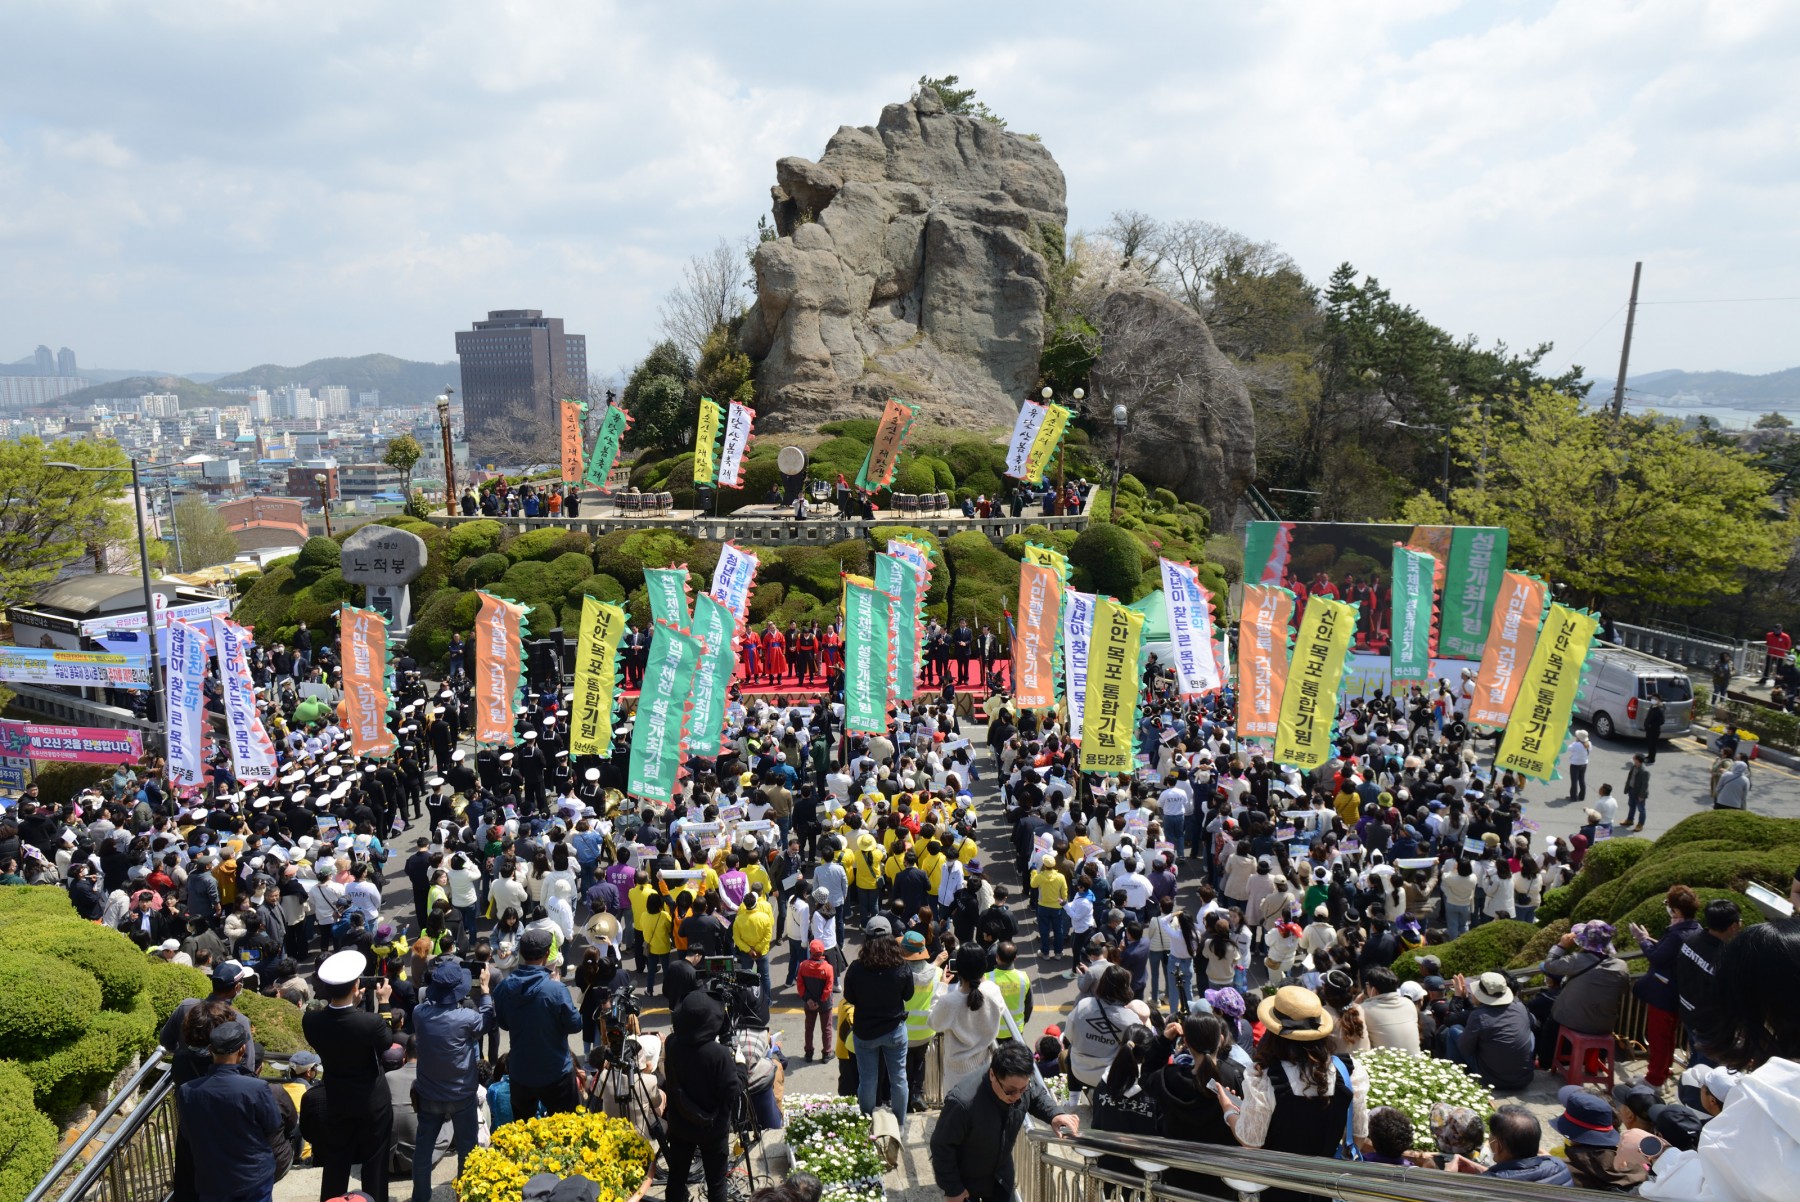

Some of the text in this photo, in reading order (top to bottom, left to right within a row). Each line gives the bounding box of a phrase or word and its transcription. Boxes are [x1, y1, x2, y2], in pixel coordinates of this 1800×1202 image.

[376, 542, 398, 550] 유달산
[353, 558, 406, 575] 노적봉
[1168, 566, 1185, 602] 청년이
[1461, 532, 1496, 635] 성공개최기원
[1028, 572, 1047, 630] 시민행복
[1173, 605, 1188, 631] 찾는
[580, 610, 611, 740] 신안 목포 통합기원
[1180, 650, 1196, 676] 목포
[1097, 609, 1129, 748] 신안 목포 통합기원
[1255, 655, 1272, 714] 건강기원
[1295, 609, 1337, 747] 신안 목포 통합기원
[1521, 618, 1577, 754] 신안 목포 통합기원
[43, 737, 62, 749] 오신
[63, 738, 81, 750] 것을
[82, 738, 131, 752] 환영합니다
[1283, 748, 1318, 764] 부흥동
[240, 765, 271, 777] 대성동
[1086, 753, 1127, 766] 용당2동
[1506, 753, 1544, 773] 하당동
[0, 770, 20, 780] 주차장
[1085, 1032, 1116, 1046] umbro
